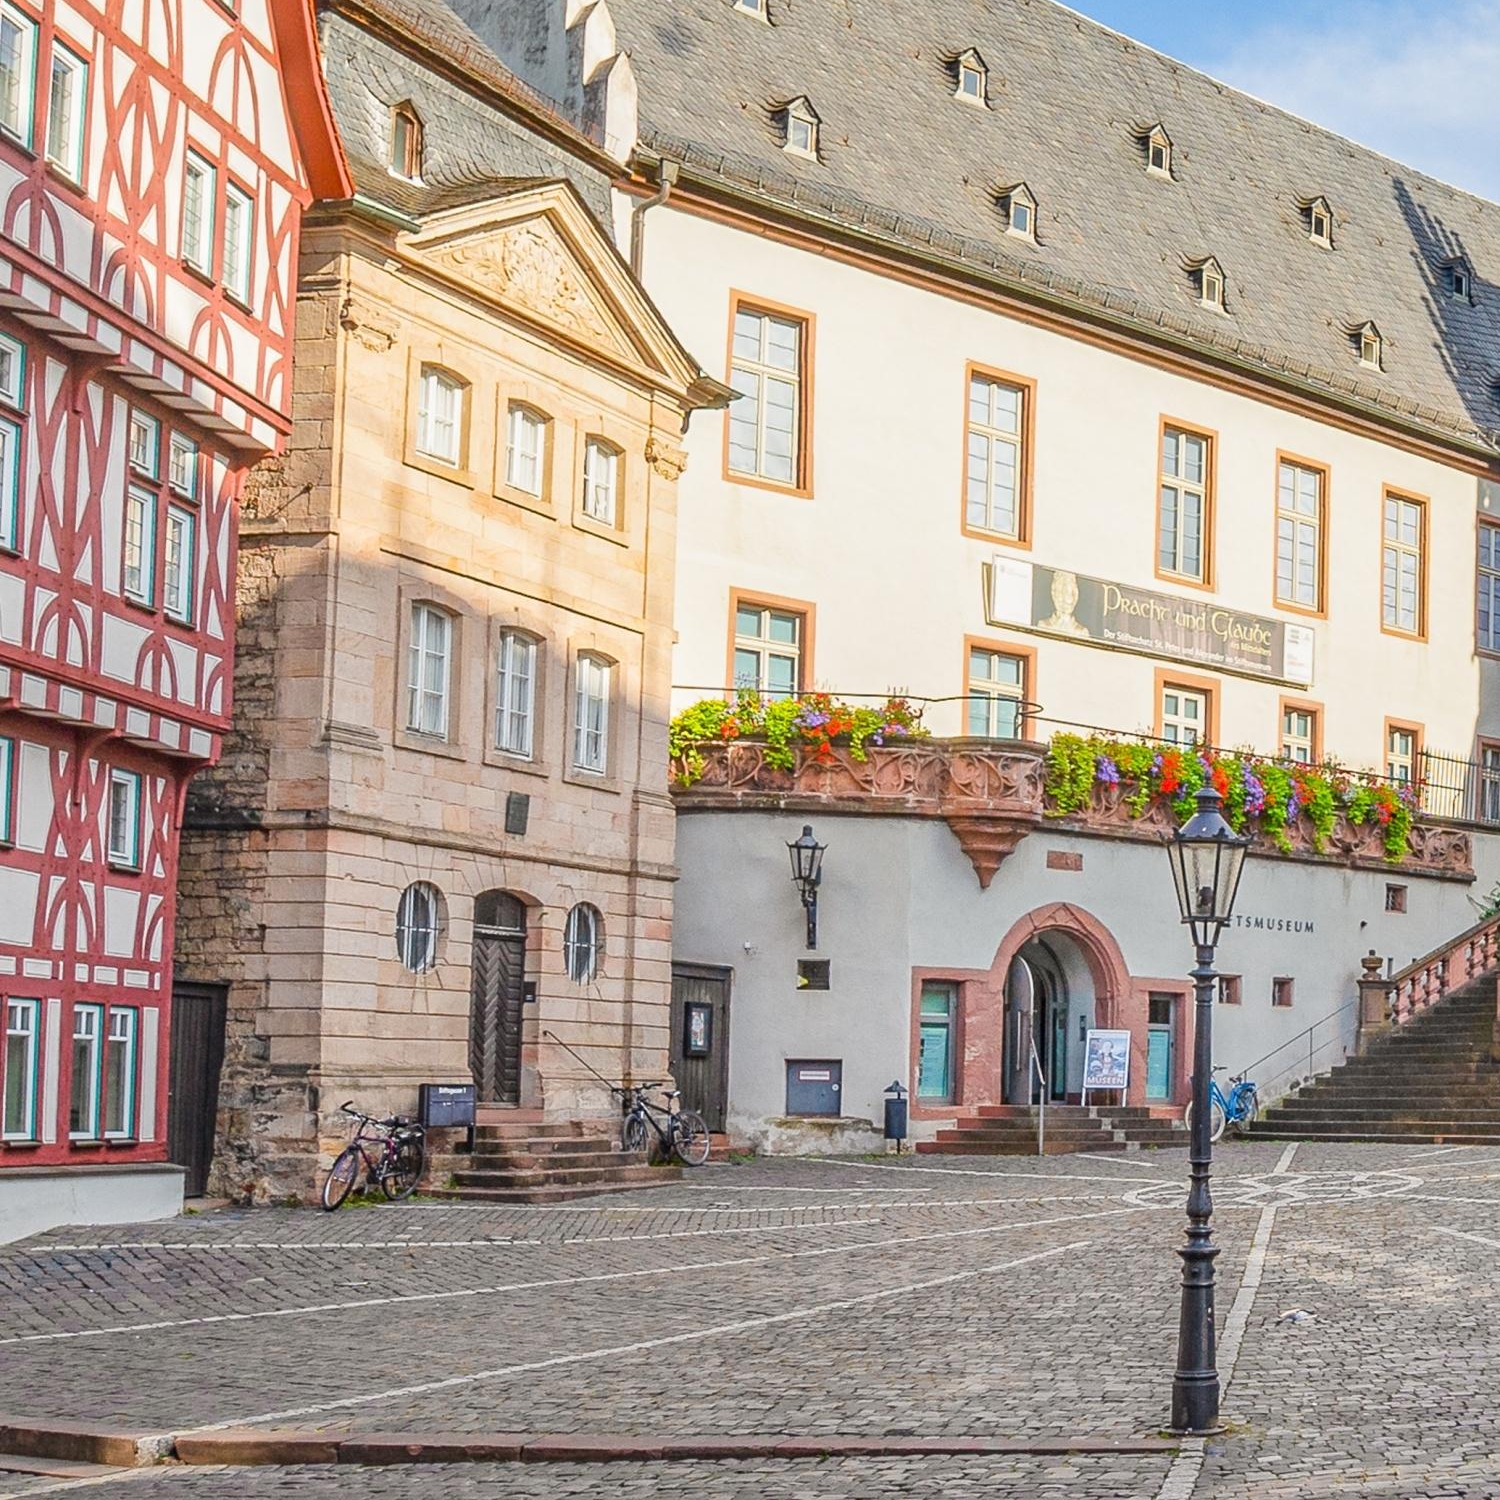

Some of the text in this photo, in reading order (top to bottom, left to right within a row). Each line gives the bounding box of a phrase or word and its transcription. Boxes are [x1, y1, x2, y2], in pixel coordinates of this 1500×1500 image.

[1102, 584, 1169, 620] Pracht
[1175, 611, 1206, 631] und
[1211, 610, 1272, 646] Glaube
[1236, 915, 1314, 933] TSMUSEUM
[1087, 1076, 1124, 1085] MUSEEN
